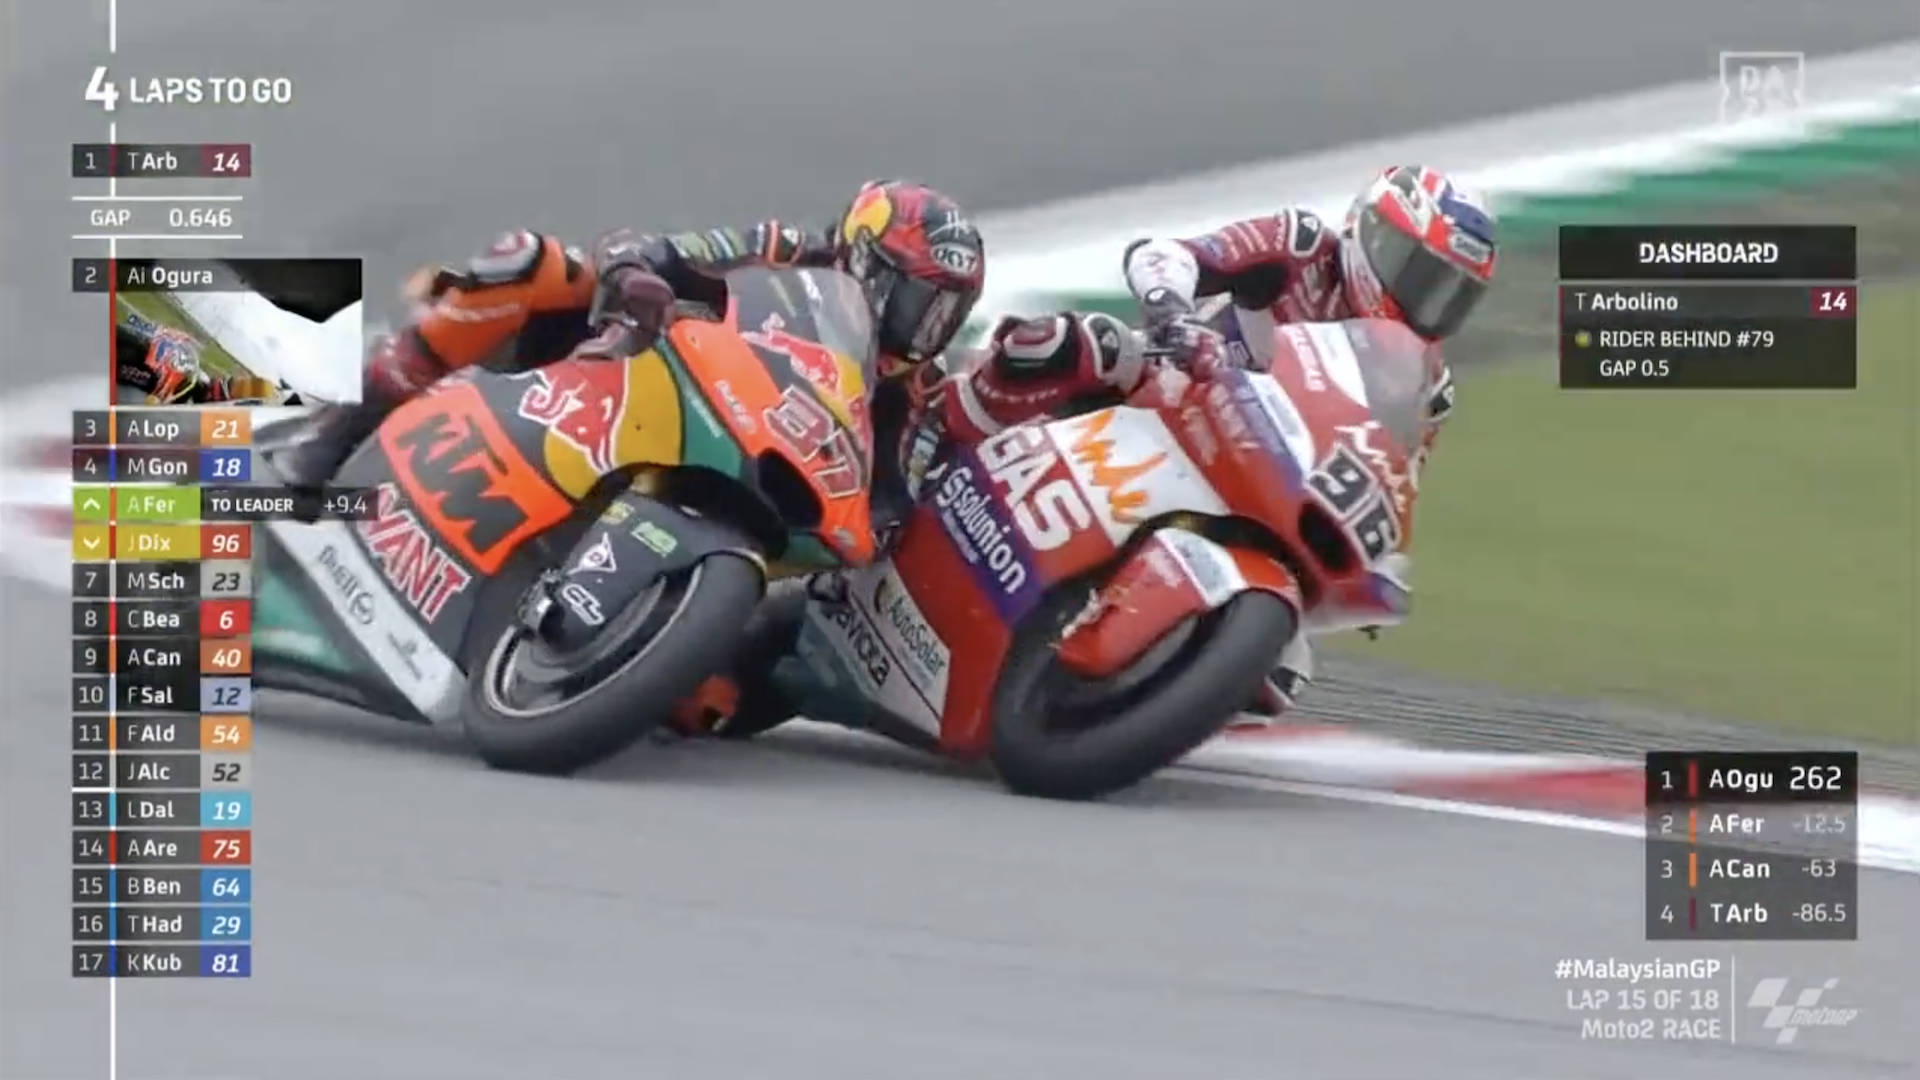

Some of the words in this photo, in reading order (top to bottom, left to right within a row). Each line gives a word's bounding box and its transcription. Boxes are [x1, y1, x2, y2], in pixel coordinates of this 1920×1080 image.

[394, 413, 530, 556] KTM
[977, 420, 1093, 551] GAS
[1303, 443, 1401, 572] 96
